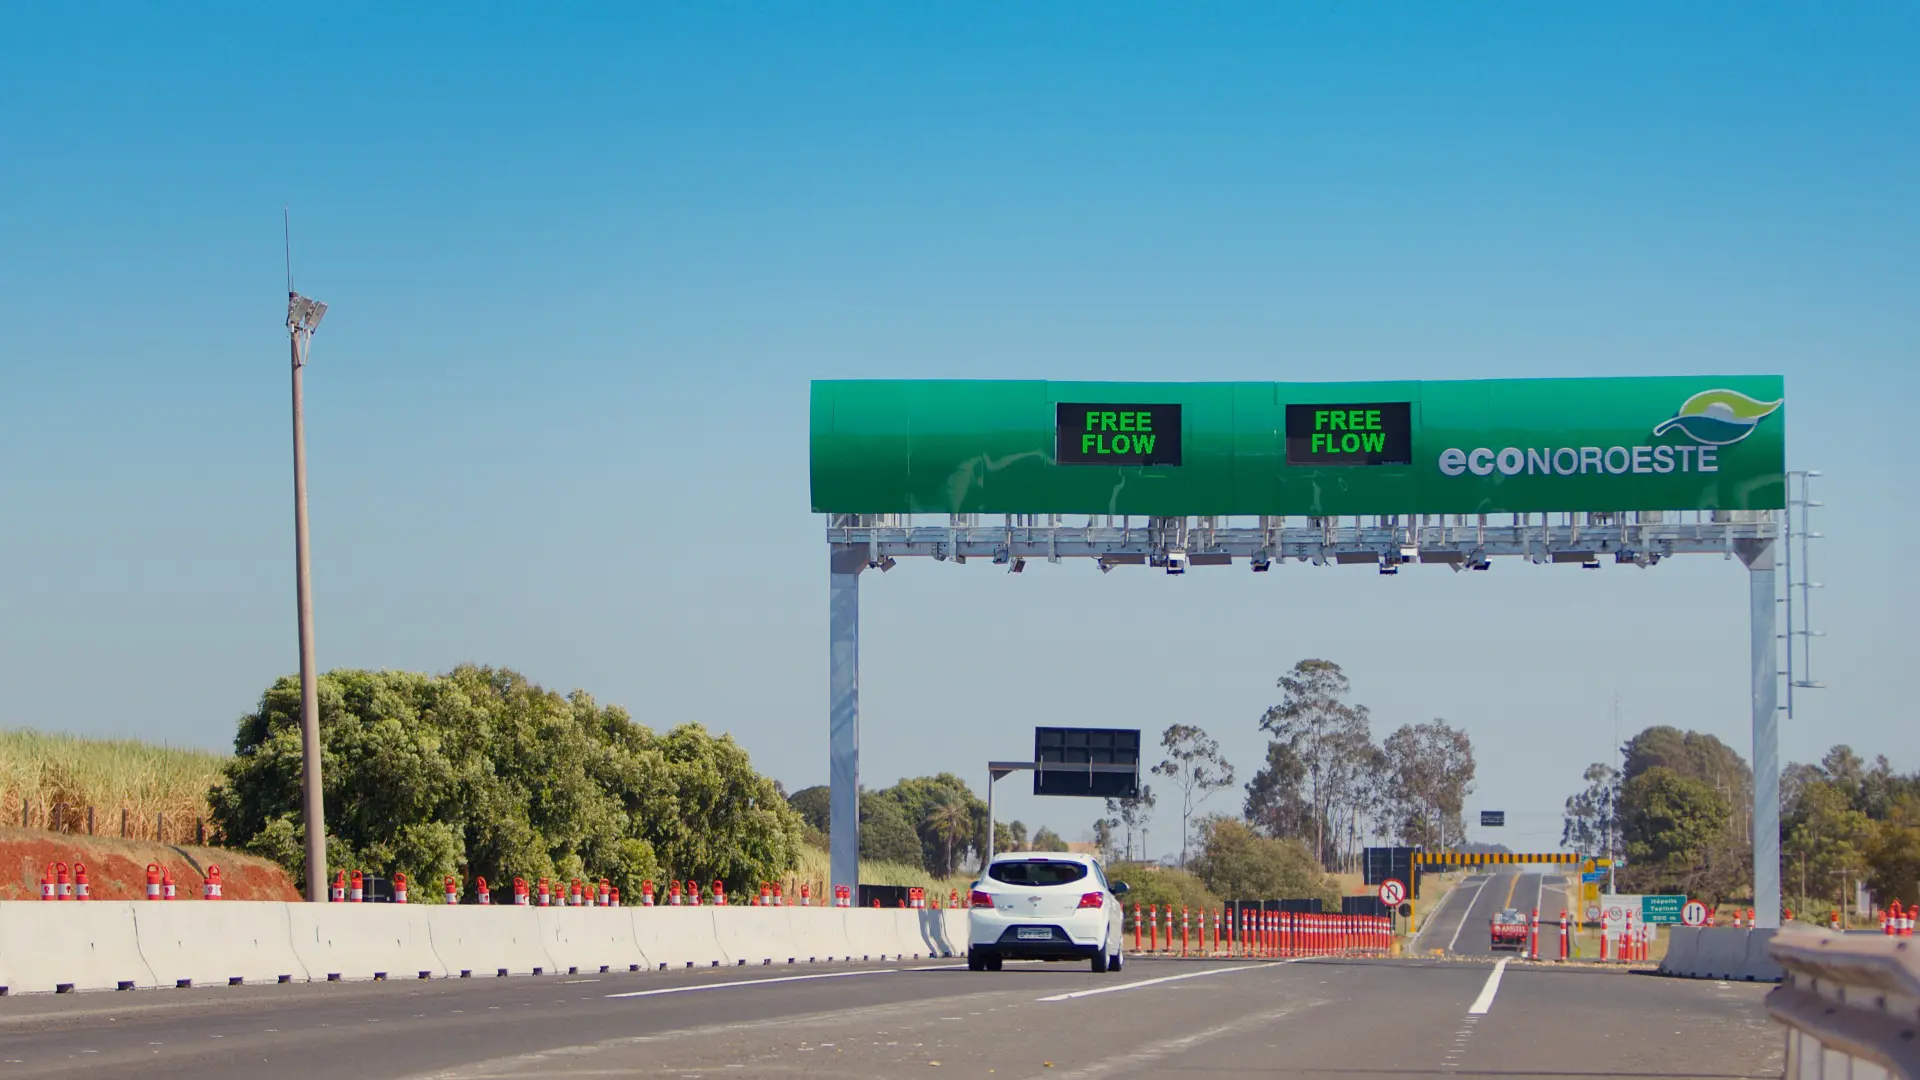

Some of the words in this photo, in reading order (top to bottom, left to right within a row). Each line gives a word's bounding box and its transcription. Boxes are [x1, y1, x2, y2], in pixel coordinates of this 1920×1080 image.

[1086, 411, 1152, 431] FREE
[1315, 410, 1382, 431] FREE
[1082, 434, 1156, 454] FLOW
[1311, 433, 1386, 453] FLOW
[1438, 445, 1719, 476] ecoNOROESTE
